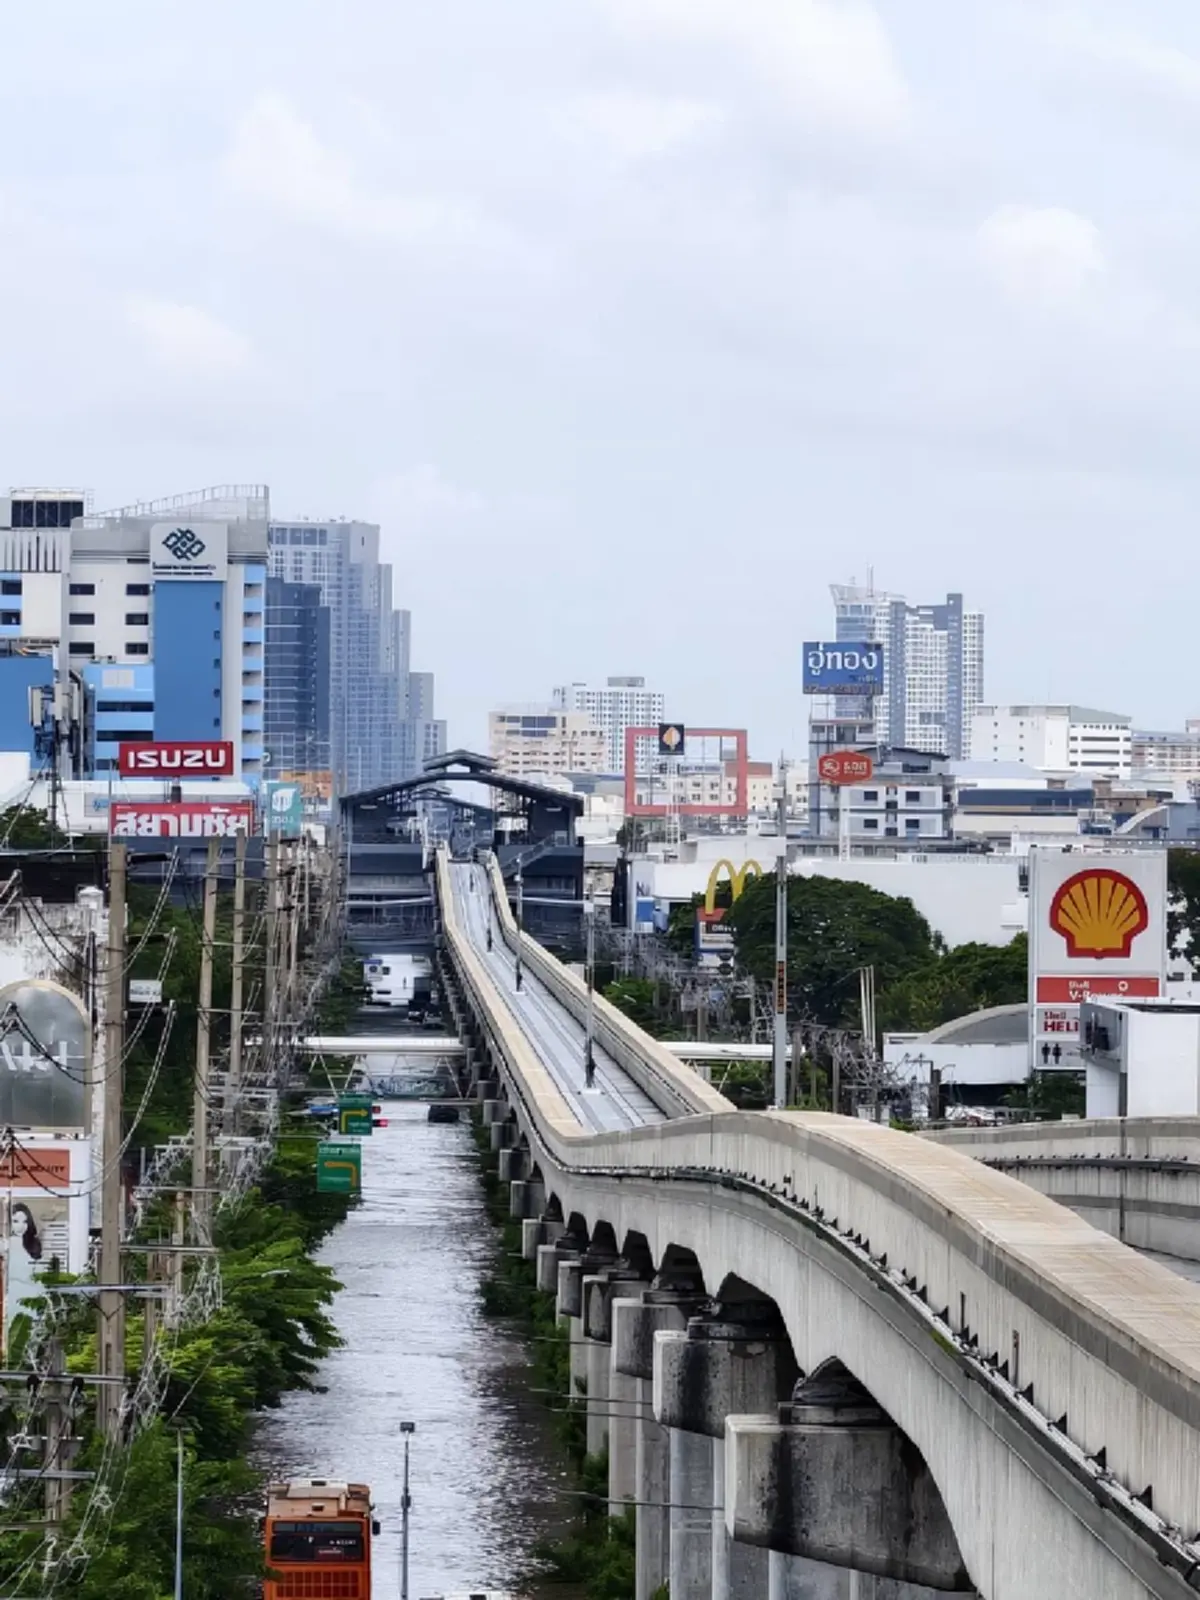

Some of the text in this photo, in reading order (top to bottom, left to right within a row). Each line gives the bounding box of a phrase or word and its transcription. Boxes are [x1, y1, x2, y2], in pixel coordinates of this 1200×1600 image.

[808, 642, 878, 675] อู่ทอง
[127, 749, 227, 769] ISUZU
[1044, 1011, 1067, 1020] Shell
[1044, 1021, 1079, 1032] HELI
